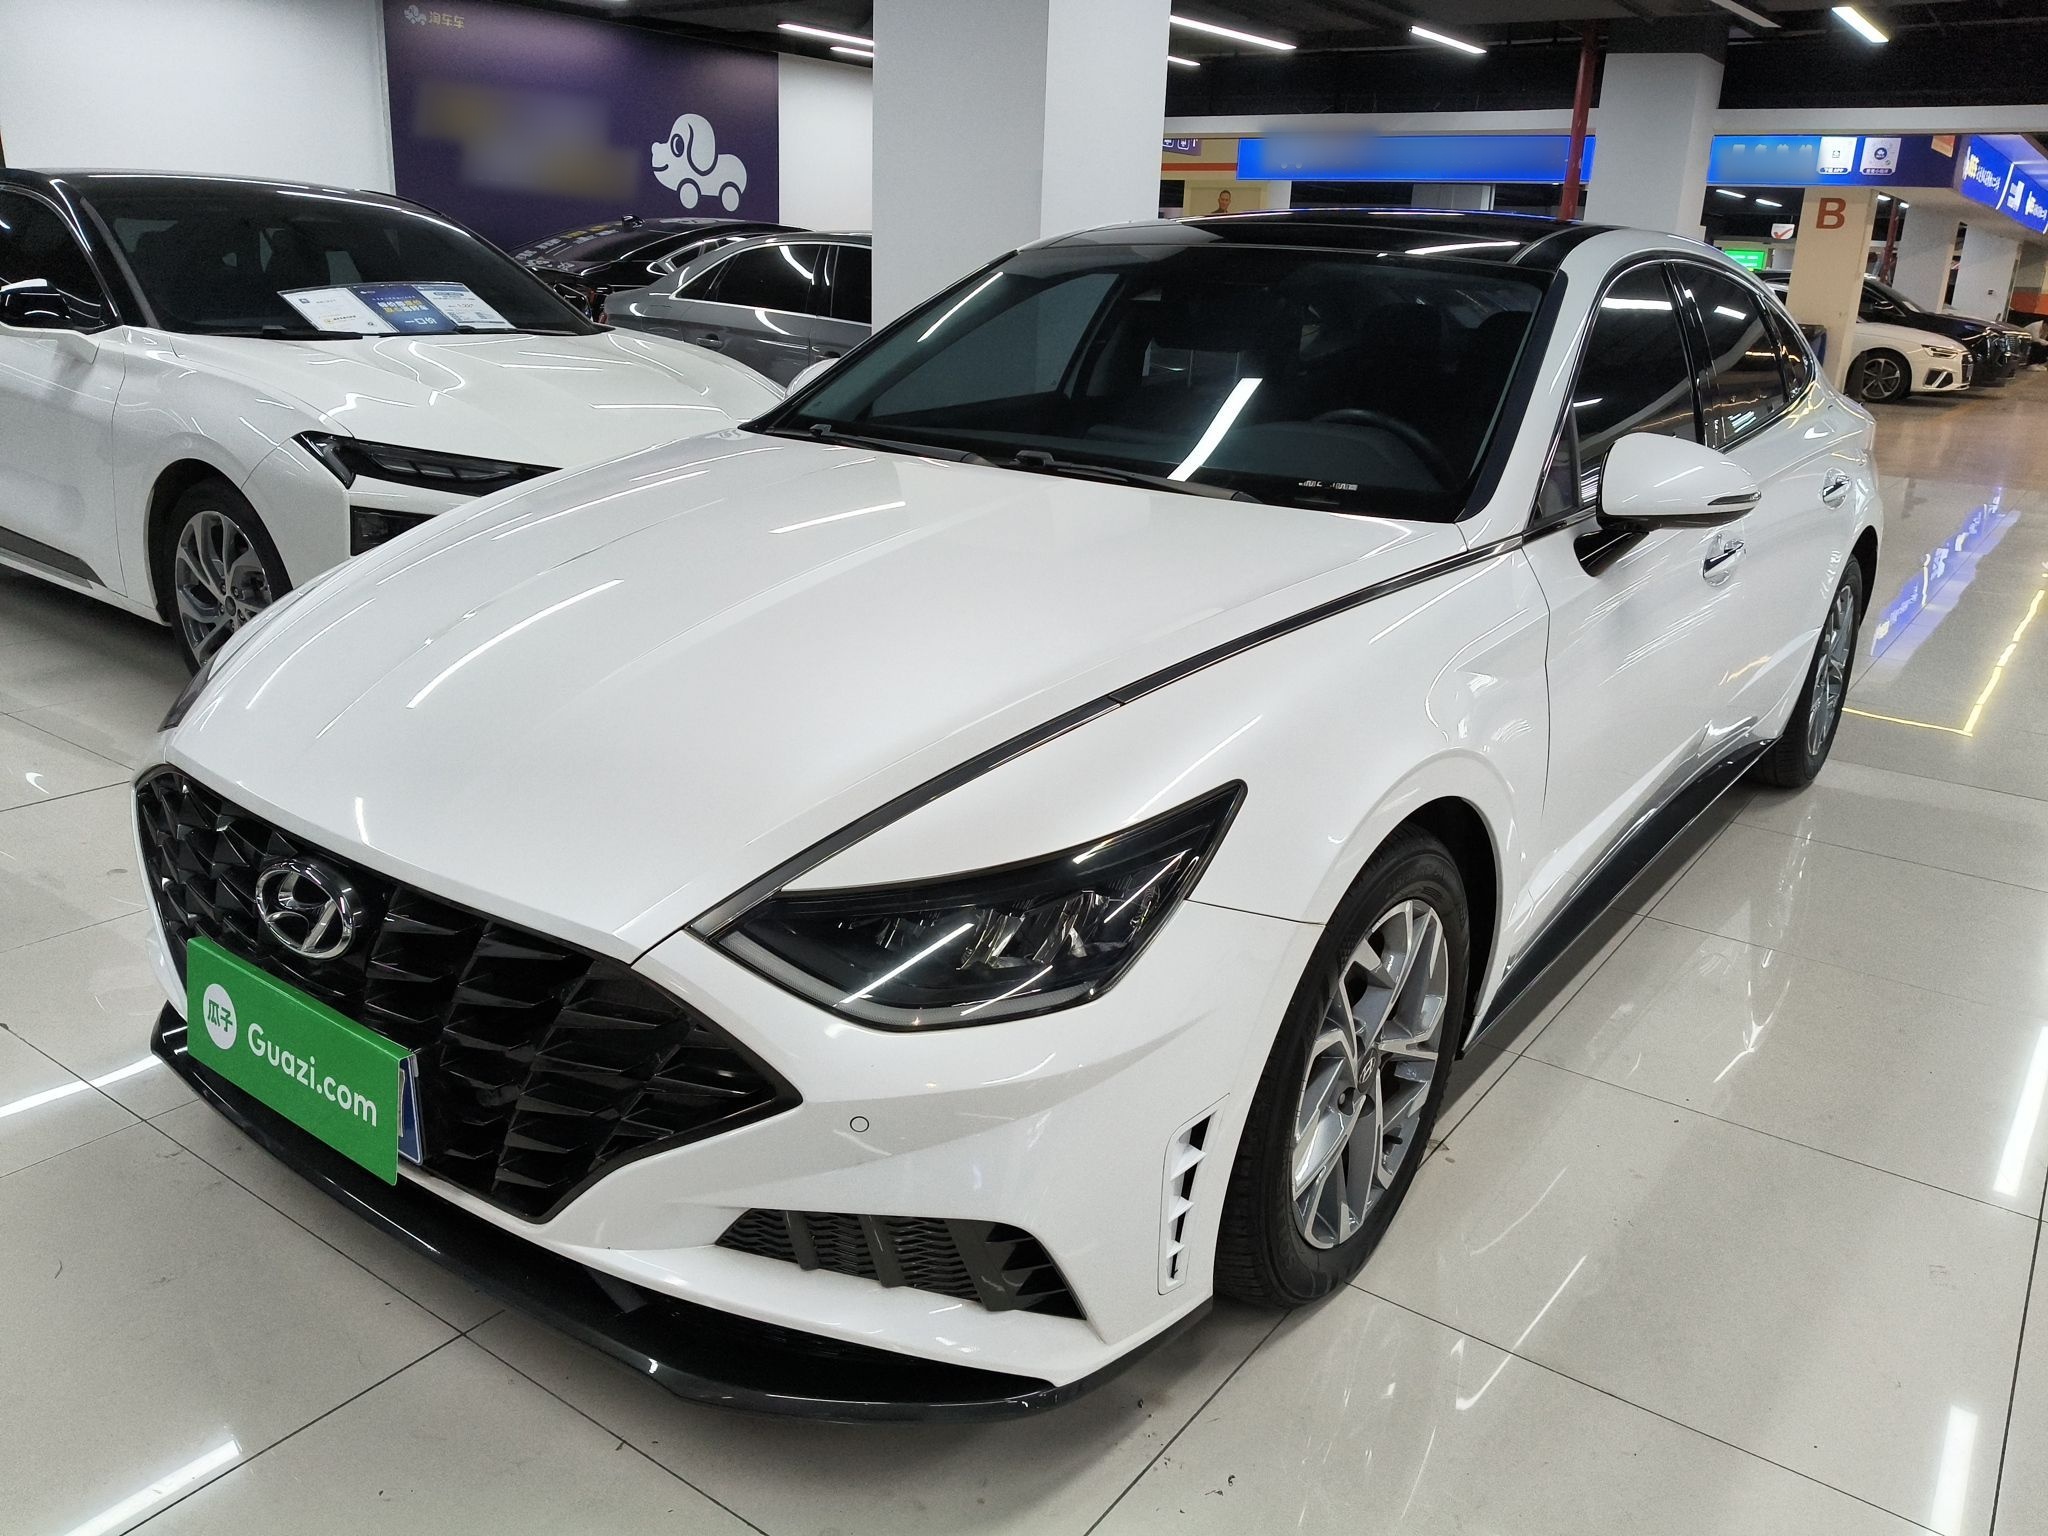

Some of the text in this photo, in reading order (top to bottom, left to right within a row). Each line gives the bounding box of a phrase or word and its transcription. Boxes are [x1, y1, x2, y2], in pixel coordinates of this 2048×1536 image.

[429, 11, 464, 28] 淘车车
[1816, 197, 1847, 230] B
[404, 316, 438, 325] 一口价
[207, 999, 378, 1128] 瓜子 Guazi.com
